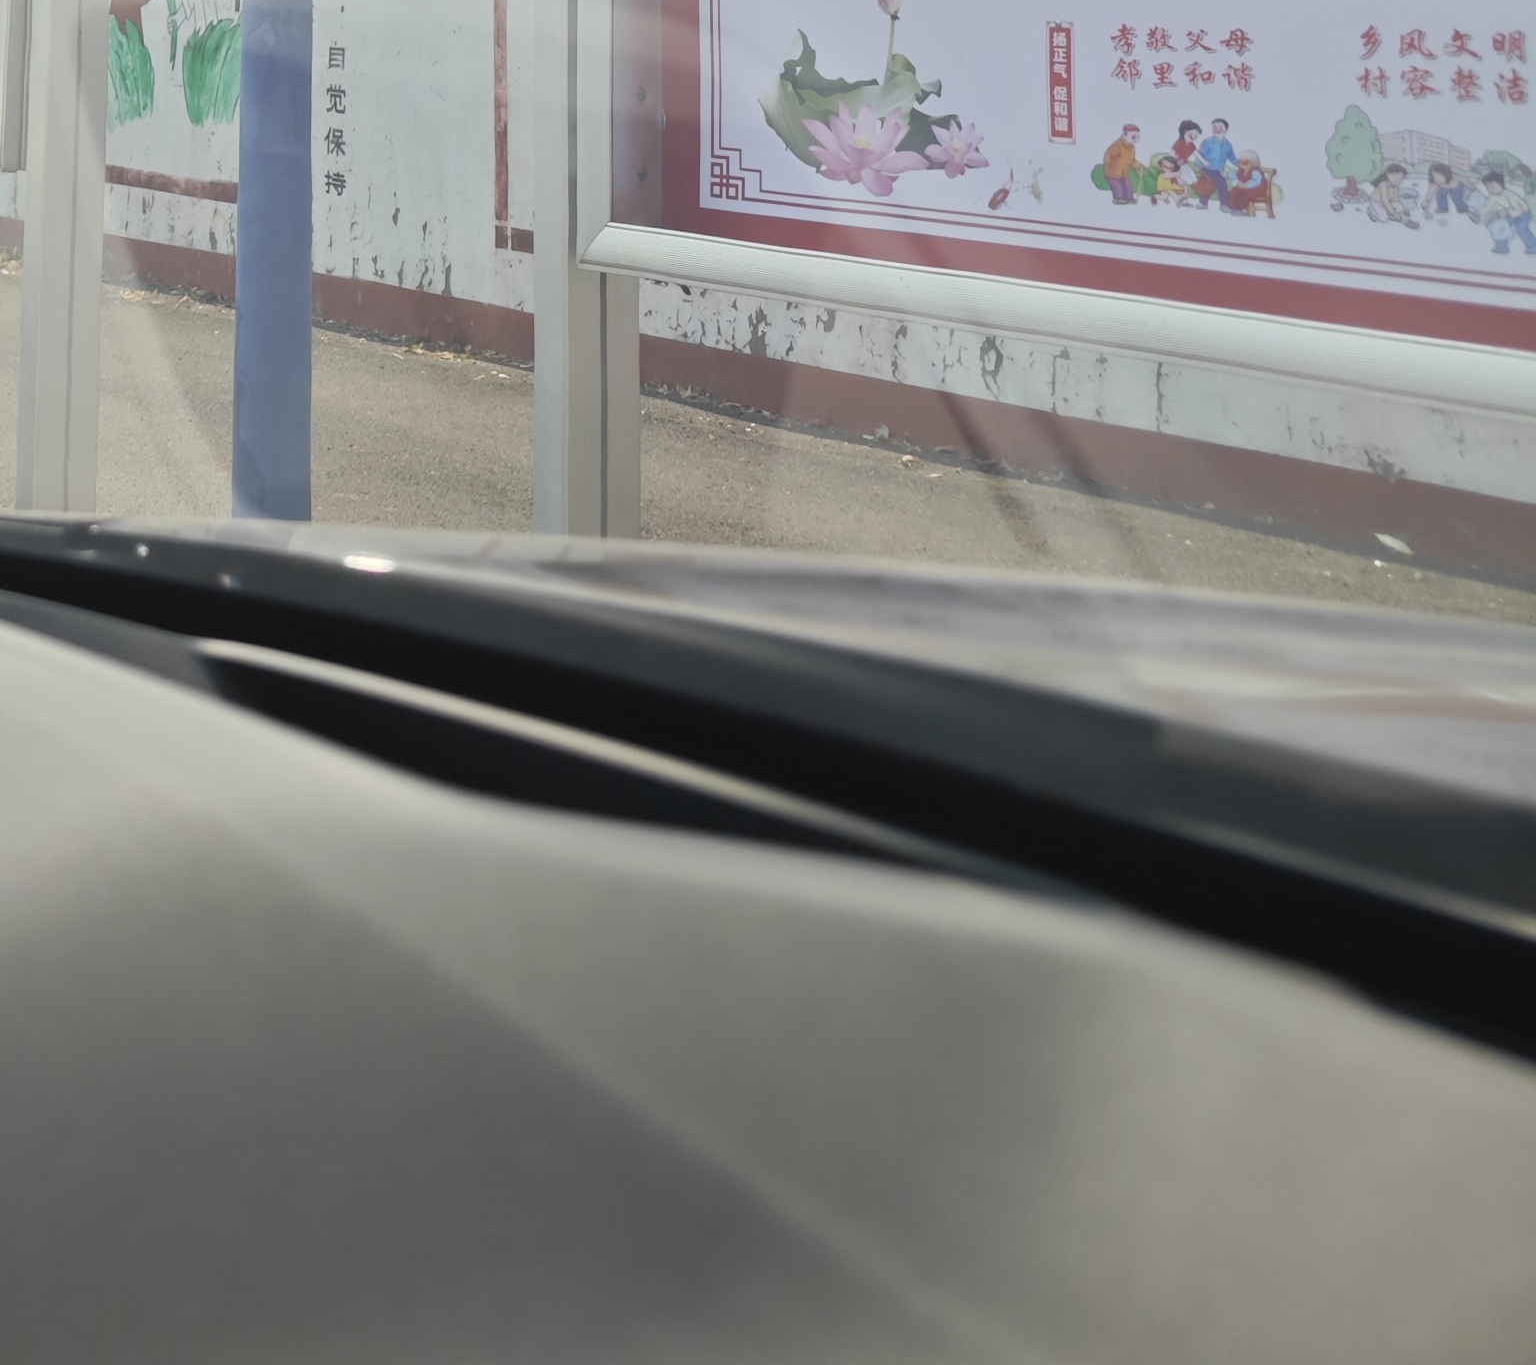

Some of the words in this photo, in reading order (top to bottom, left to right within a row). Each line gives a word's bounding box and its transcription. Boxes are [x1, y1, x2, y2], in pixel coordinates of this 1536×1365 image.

[1110, 23, 1254, 56] 孝敬父母
[1359, 24, 1527, 64] 乡风文明
[1110, 57, 1255, 92] 邻里和谐
[1356, 65, 1529, 105] 村容整洁
